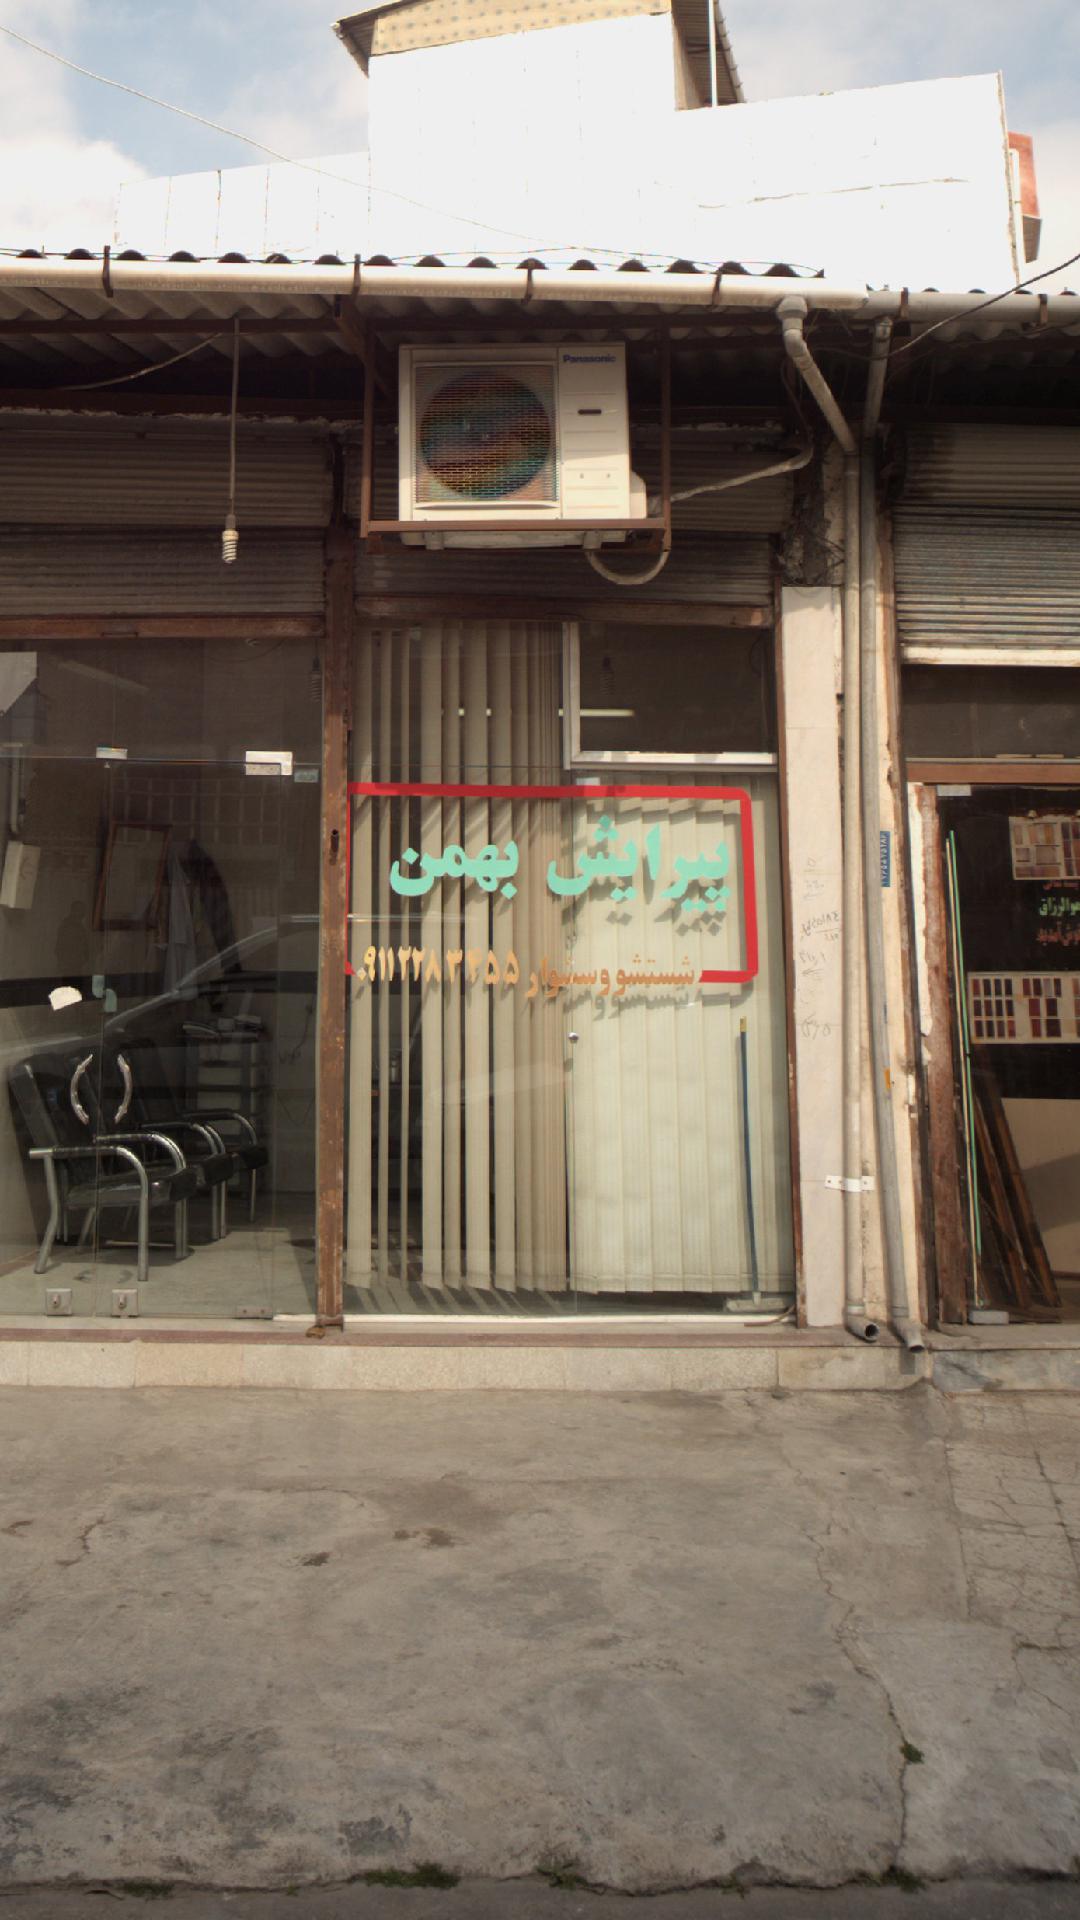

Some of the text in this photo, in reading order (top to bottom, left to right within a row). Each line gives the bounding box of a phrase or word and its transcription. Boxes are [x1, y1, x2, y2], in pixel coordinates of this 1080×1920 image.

[562, 353, 617, 363] Panasonic
[390, 840, 520, 900] بهمن
[546, 814, 732, 912] پیرایش
